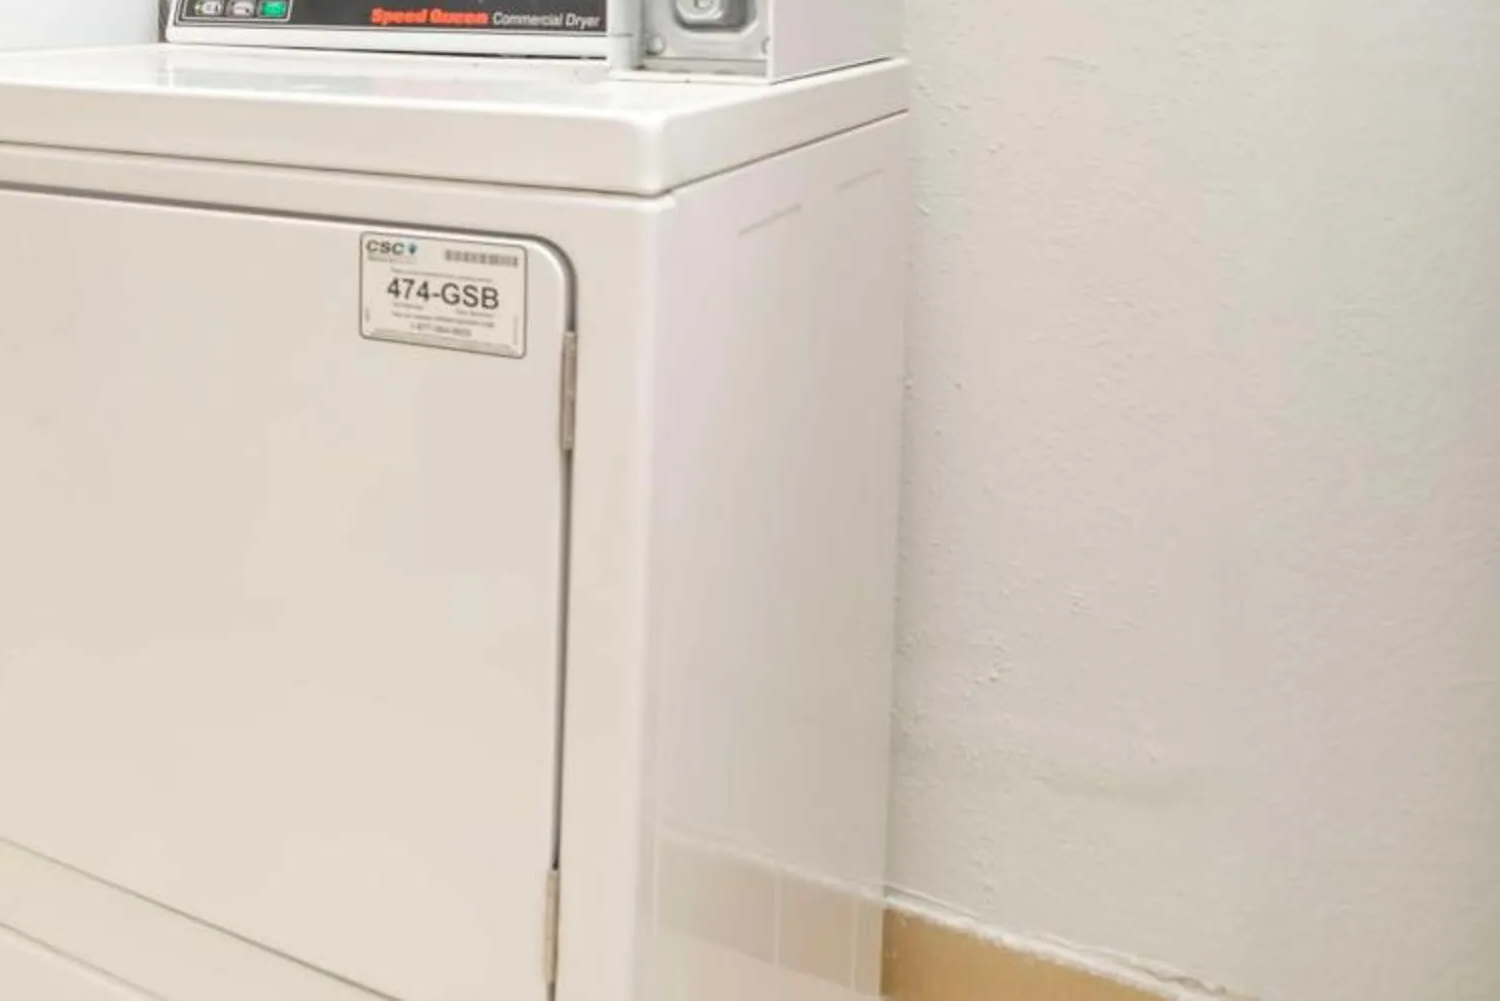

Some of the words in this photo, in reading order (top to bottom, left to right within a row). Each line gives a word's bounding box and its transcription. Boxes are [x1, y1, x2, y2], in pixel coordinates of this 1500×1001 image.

[370, 7, 428, 26] Speed
[492, 11, 563, 25] Commercial
[565, 12, 601, 29] Dryer
[365, 239, 405, 256] CSC
[387, 277, 500, 310] 474-GSB
